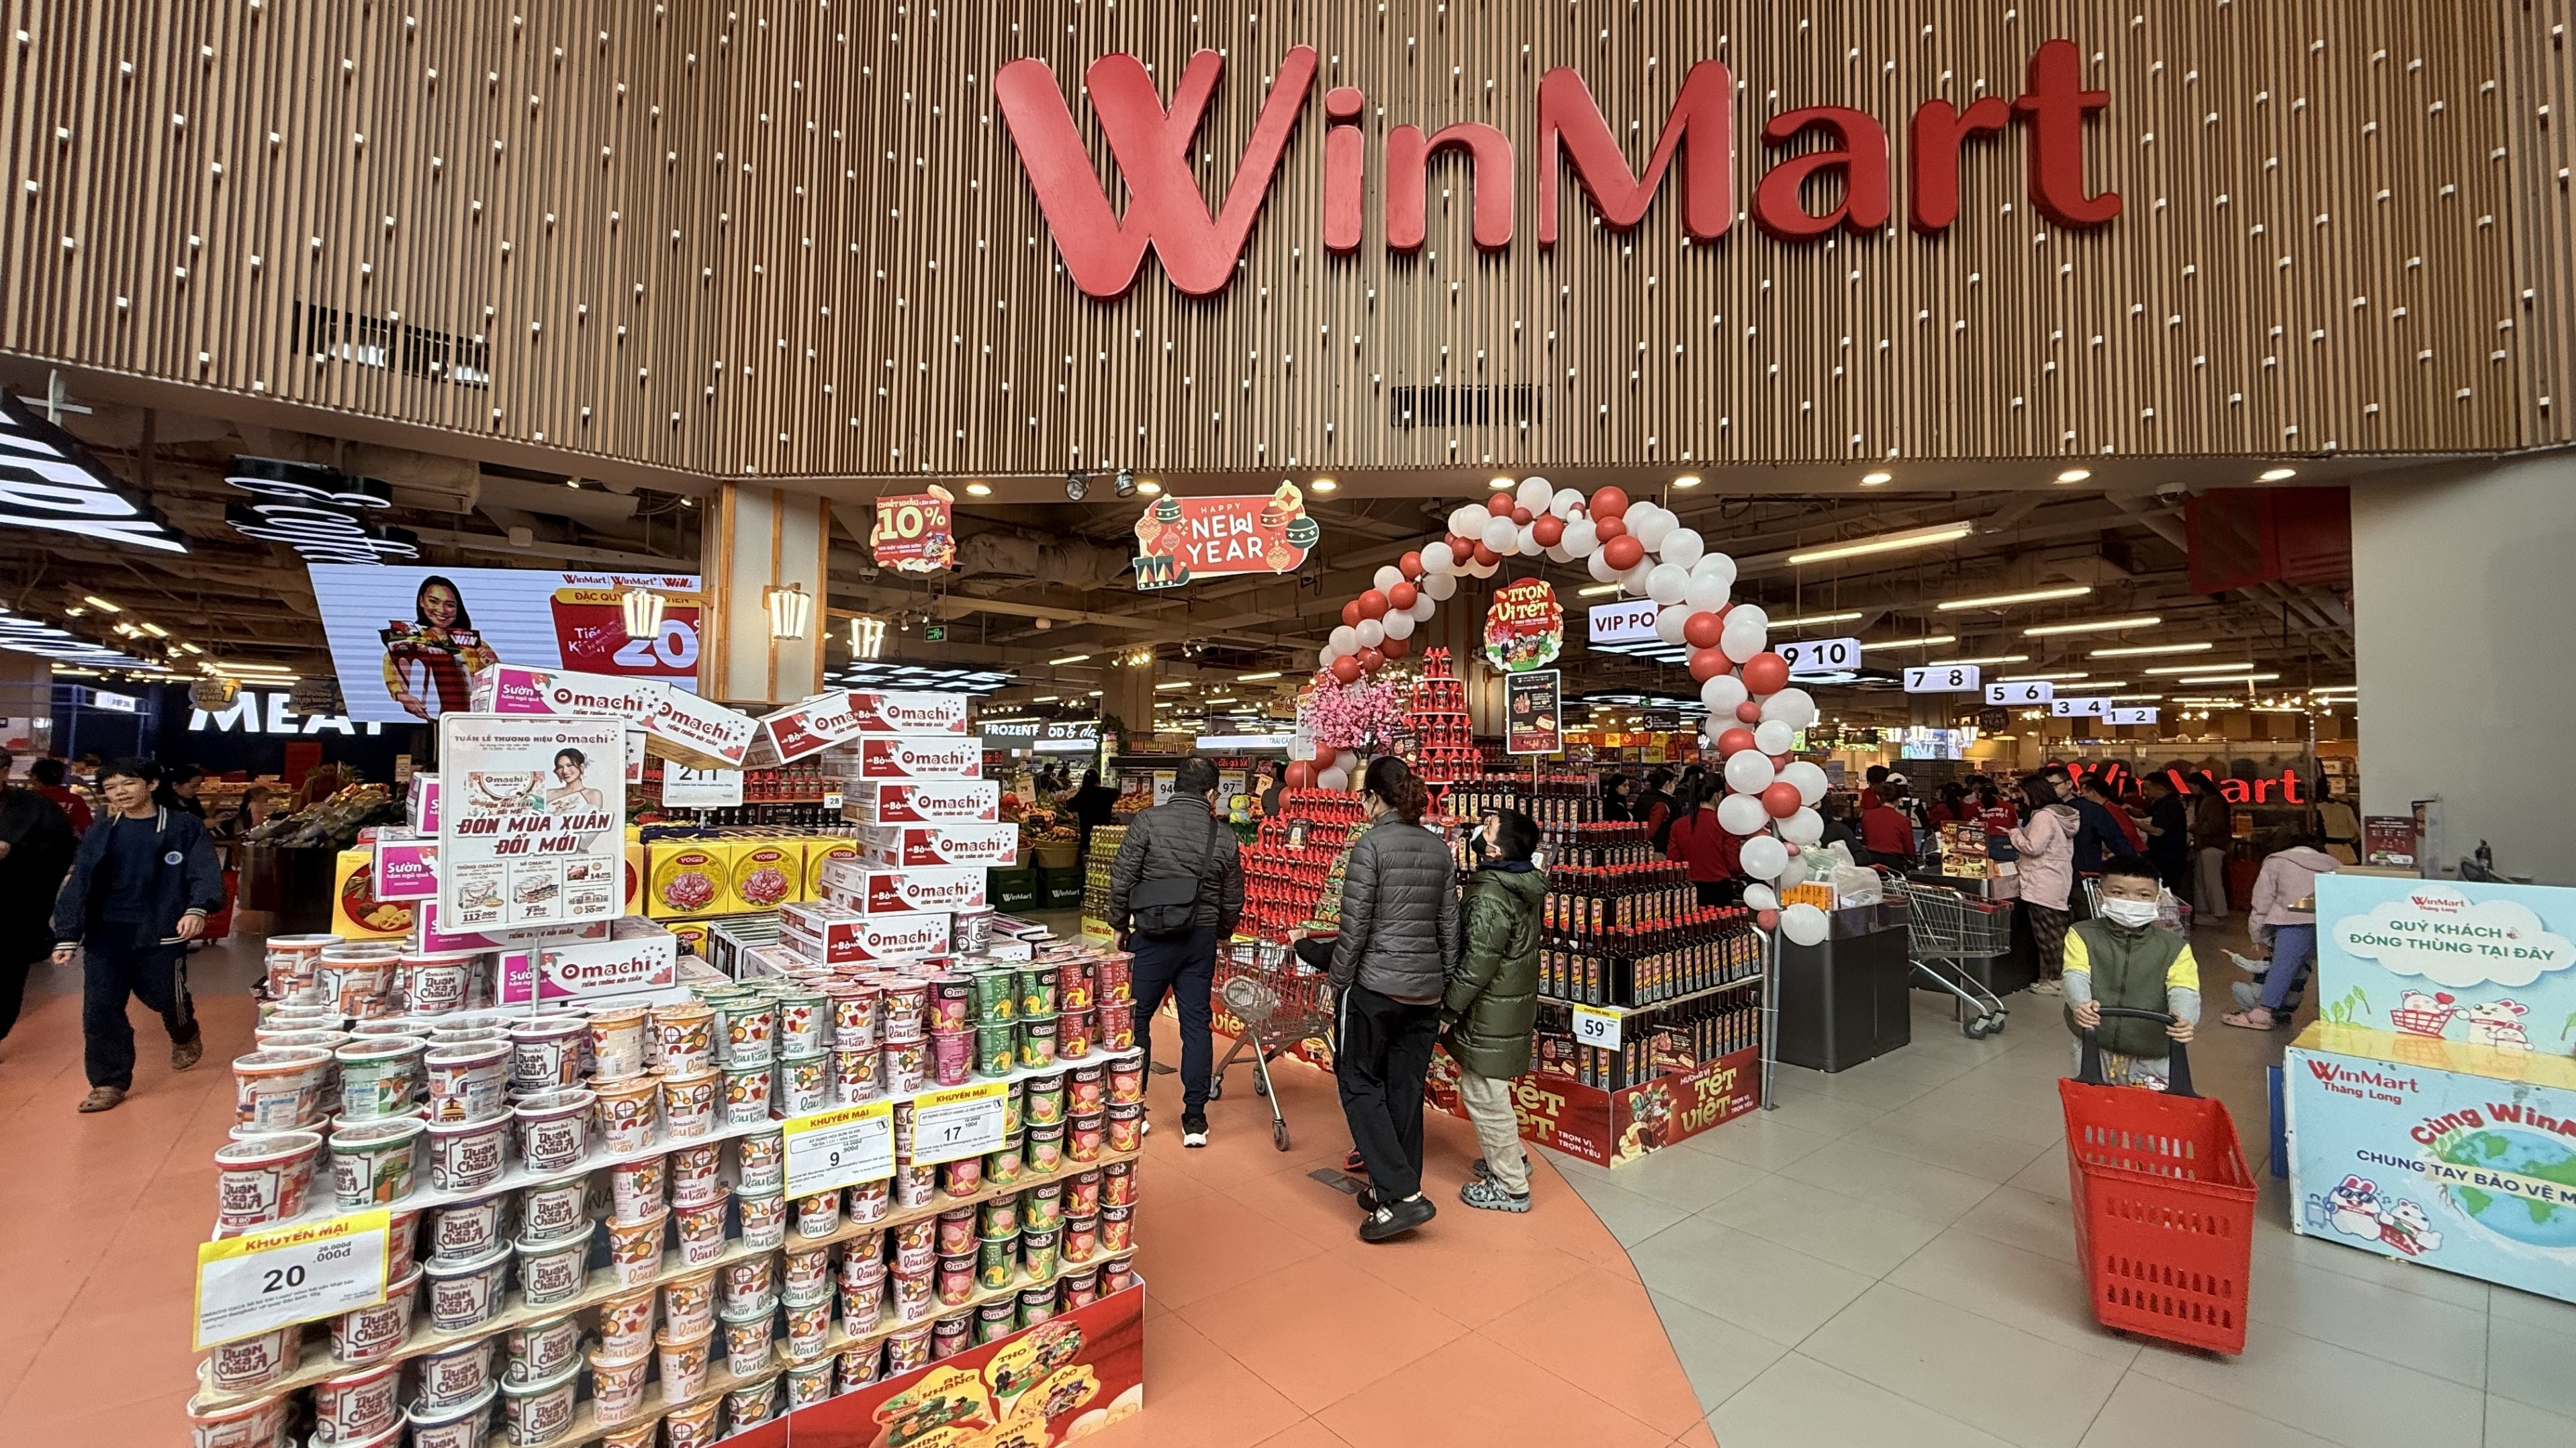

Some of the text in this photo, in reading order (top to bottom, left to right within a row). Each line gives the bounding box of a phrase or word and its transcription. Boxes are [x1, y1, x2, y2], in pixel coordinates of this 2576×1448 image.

[994, 39, 2123, 300] WinMart
[1201, 502, 1240, 514] HAPPY
[878, 506, 946, 540] 10%
[1191, 512, 1254, 540] NEW
[1186, 536, 1263, 565] YEAR
[563, 574, 606, 584] WinMart
[1596, 612, 1658, 632] VIP PO
[1784, 643, 1846, 667] 9 10
[1913, 670, 1963, 687] 7 8
[503, 683, 534, 697] Sườn
[1993, 685, 2039, 702] 5 6
[554, 688, 644, 712] Omachi
[2058, 700, 2101, 714] 3 4
[659, 702, 731, 740] Omachi
[815, 710, 854, 731] Oma
[887, 706, 950, 721] Omachi
[2135, 710, 2146, 722] 2
[1645, 716, 1653, 728] 3
[556, 734, 608, 743] Omachi
[788, 732, 801, 743] Bò
[985, 724, 1031, 736] FROZEN
[1032, 725, 1064, 738] FOD
[873, 756, 885, 765] Bò
[902, 750, 964, 765] Omachi
[1223, 783, 1236, 793] 97
[889, 801, 901, 810] Bò
[917, 794, 981, 810] Omachi
[457, 810, 610, 834] ĐÓN MÙA XUÂN
[494, 831, 577, 855] ĐỔI MỚI
[913, 844, 925, 854] Bò
[941, 837, 1001, 853] Omachi
[387, 862, 422, 873] Sườn
[878, 891, 891, 900] Bò
[907, 882, 969, 898] Omachi
[1003, 893, 1032, 902] WinMart
[2411, 896, 2465, 908] WinMart
[2389, 919, 2502, 939] QUÝ KHÁCH
[838, 940, 851, 950] Bò
[868, 928, 932, 947] Omachi
[2350, 932, 2555, 961] ĐÓNG THÙNG TẠI ĐÂY
[561, 955, 651, 980] Omachi
[1583, 1019, 1605, 1037] 59
[2307, 1059, 2420, 1094] WinMart
[937, 1087, 987, 1103] KHUYẾN MẠI
[2322, 1081, 2401, 1105] Thăng Long
[810, 1109, 869, 1127] KHUYẾN MẠI
[2411, 1107, 2485, 1145] Cùng
[944, 1126, 962, 1141] 17
[1558, 1130, 1581, 1144] TRỌN
[1558, 1139, 1601, 1159] TRỌN YÊU
[830, 1152, 839, 1167] 9
[2356, 1149, 2426, 1173] CHUNG
[2430, 1163, 2469, 1181] TAY
[2475, 1172, 2519, 1192] BẢO
[2525, 1184, 2553, 1202] VỆ
[245, 1222, 349, 1251] KHUYẾN MẠI
[262, 1265, 306, 1294] 20
[944, 1373, 965, 1385] AN
